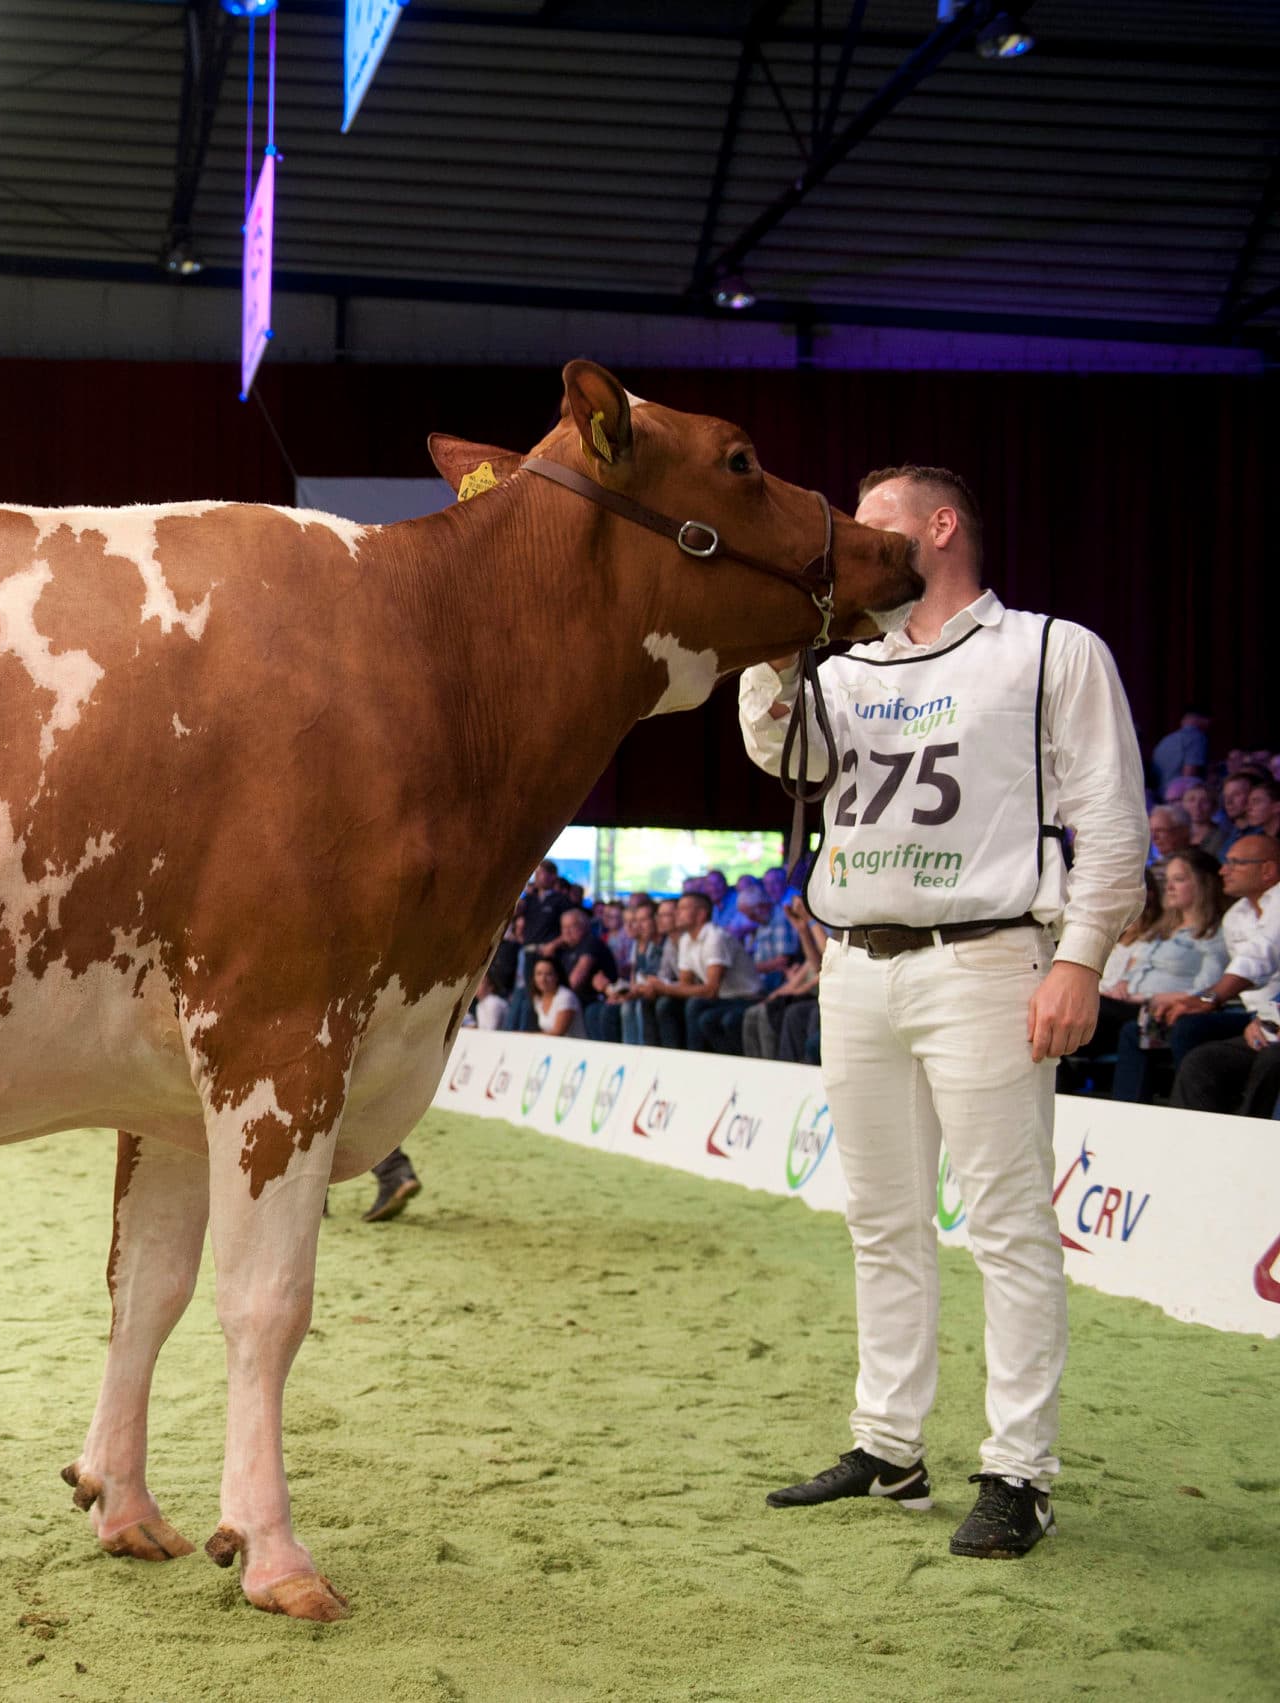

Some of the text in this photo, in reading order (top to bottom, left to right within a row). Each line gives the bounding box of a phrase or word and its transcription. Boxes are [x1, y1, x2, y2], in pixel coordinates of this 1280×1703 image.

[855, 695, 953, 721] uniform
[902, 702, 959, 740] agri
[834, 741, 961, 827] 275
[851, 843, 963, 875] agrifirm
[913, 871, 959, 889] feed
[726, 1114, 762, 1150] CRV
[1077, 1184, 1151, 1243] CRV
